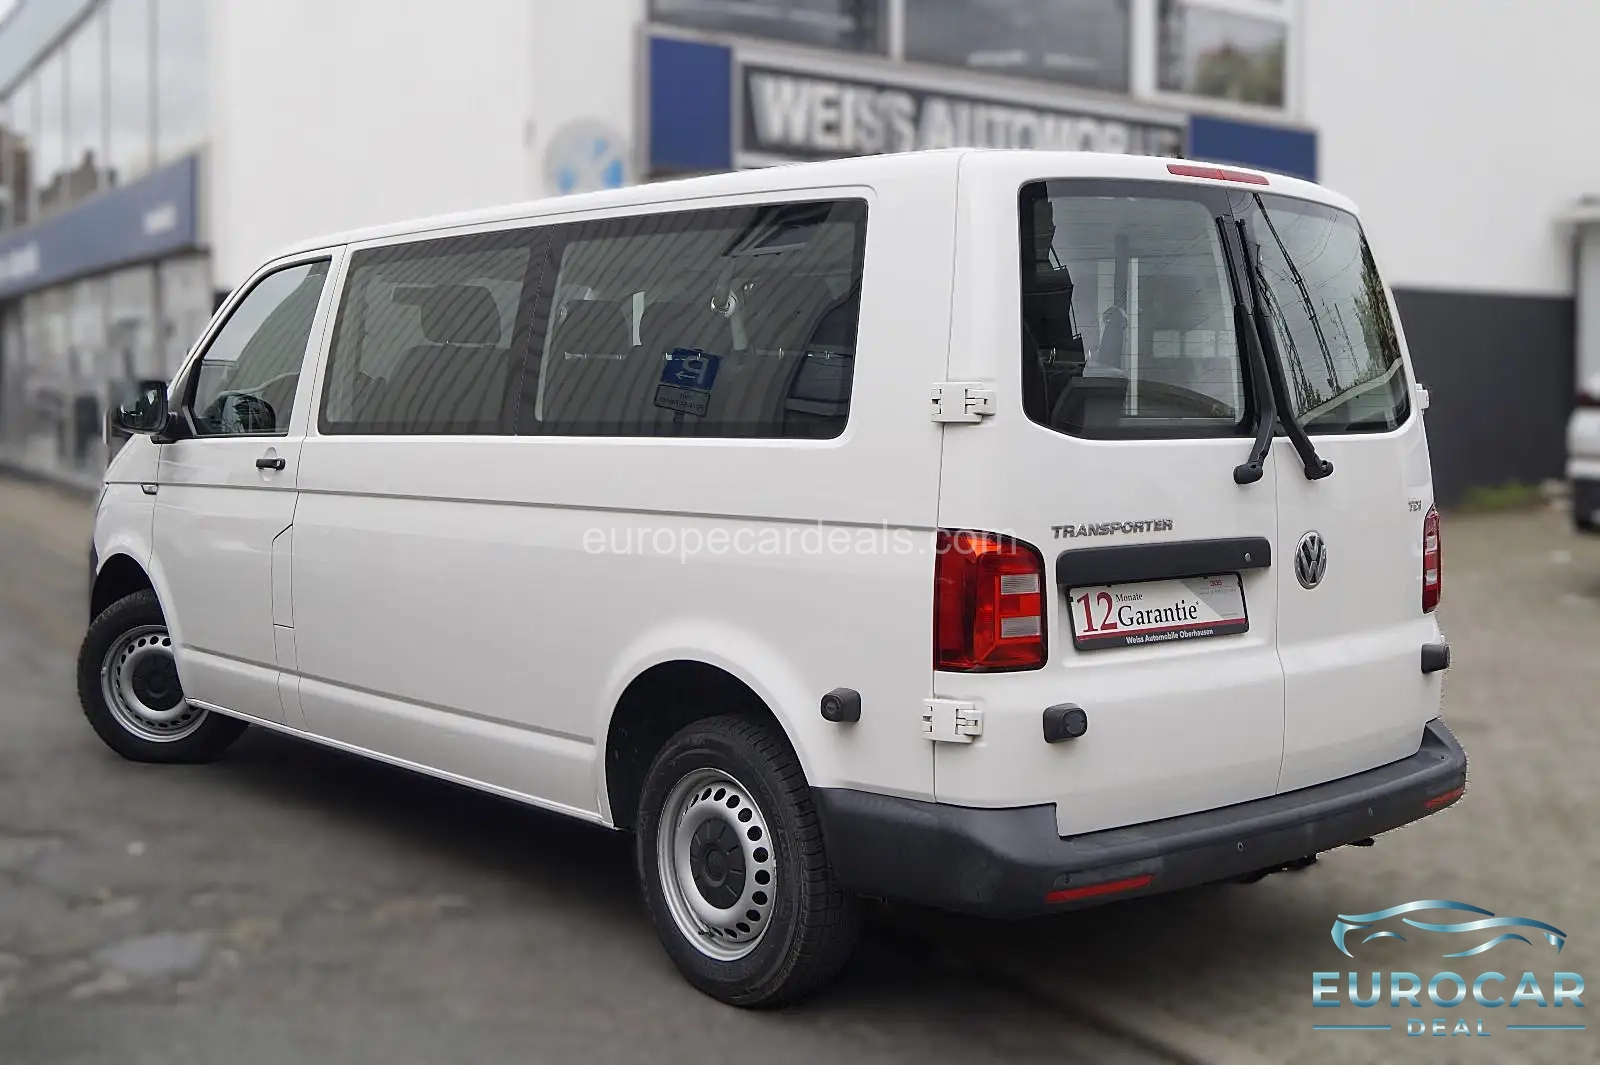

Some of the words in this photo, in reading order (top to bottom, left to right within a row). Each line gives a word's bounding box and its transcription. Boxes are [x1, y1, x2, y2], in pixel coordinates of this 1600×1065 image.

[749, 73, 916, 153] WEISS
[1050, 519, 1174, 540] TRANSPORTER
[1115, 592, 1143, 603] Monate
[1076, 591, 1118, 633] 12
[1126, 634, 1145, 645] Weiss
[1145, 631, 1179, 643] Automobile
[1179, 628, 1214, 640] Oberhausen
